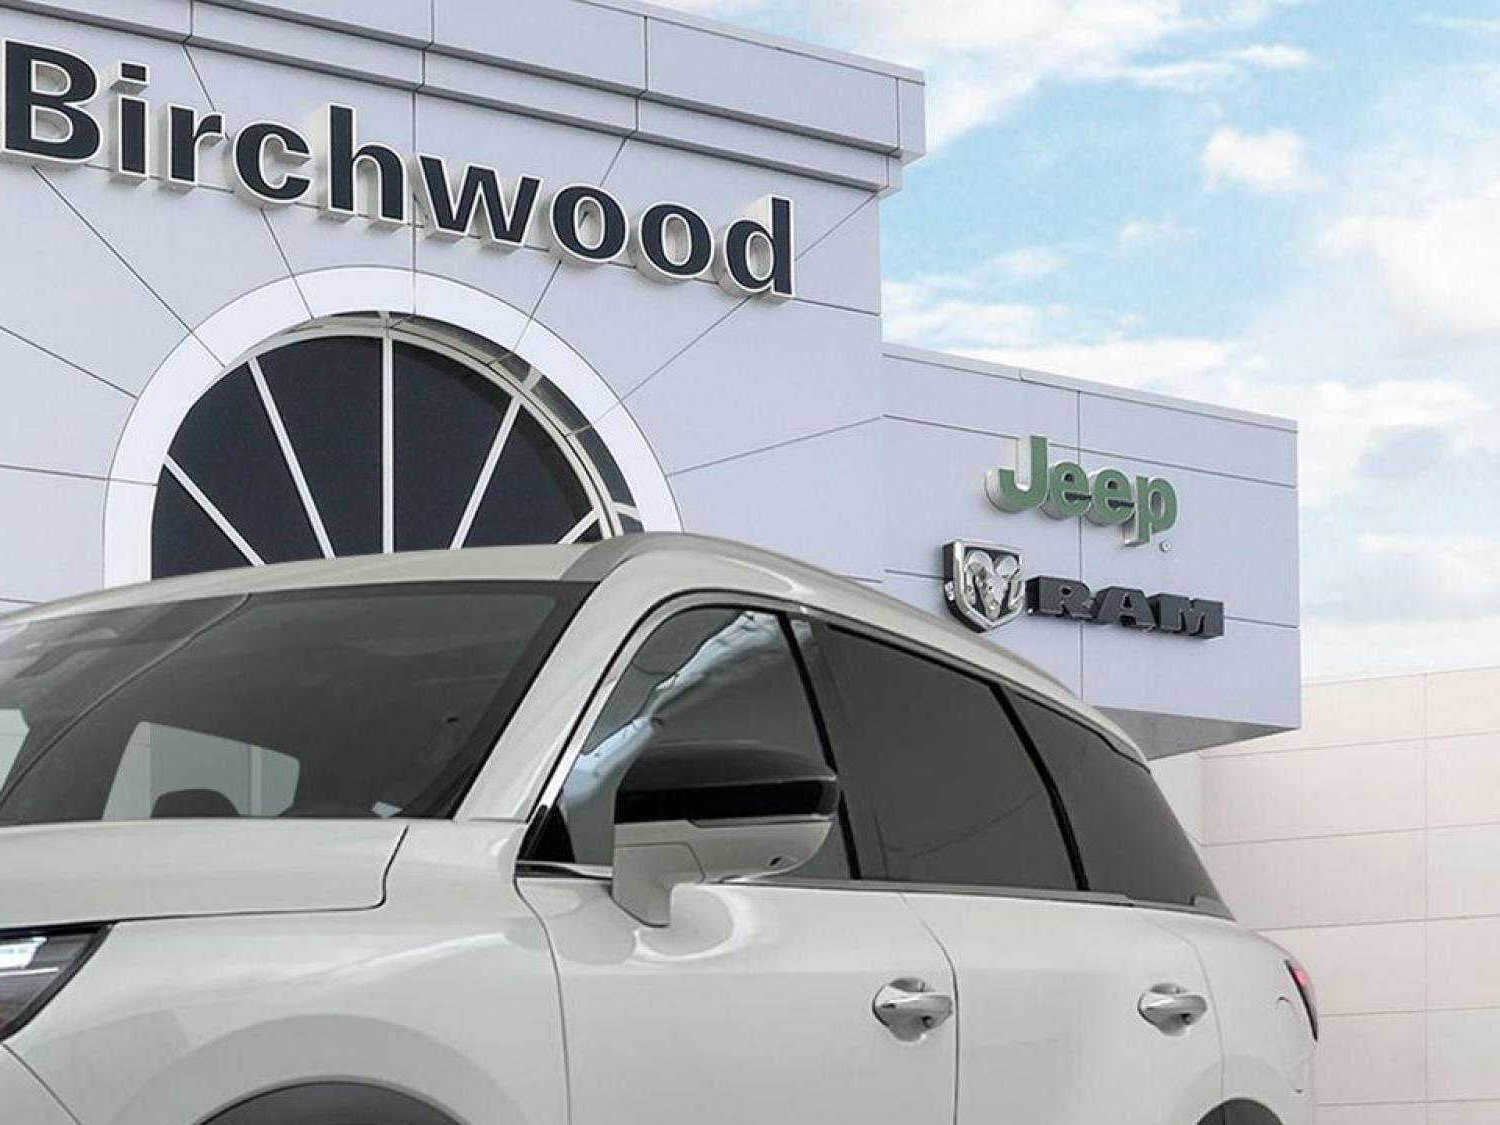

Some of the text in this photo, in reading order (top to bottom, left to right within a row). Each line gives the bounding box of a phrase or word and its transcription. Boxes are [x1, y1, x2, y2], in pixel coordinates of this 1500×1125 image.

[0, 37, 797, 299] Birchwood
[986, 434, 1178, 547] Jeep
[1026, 576, 1225, 639] RAM
